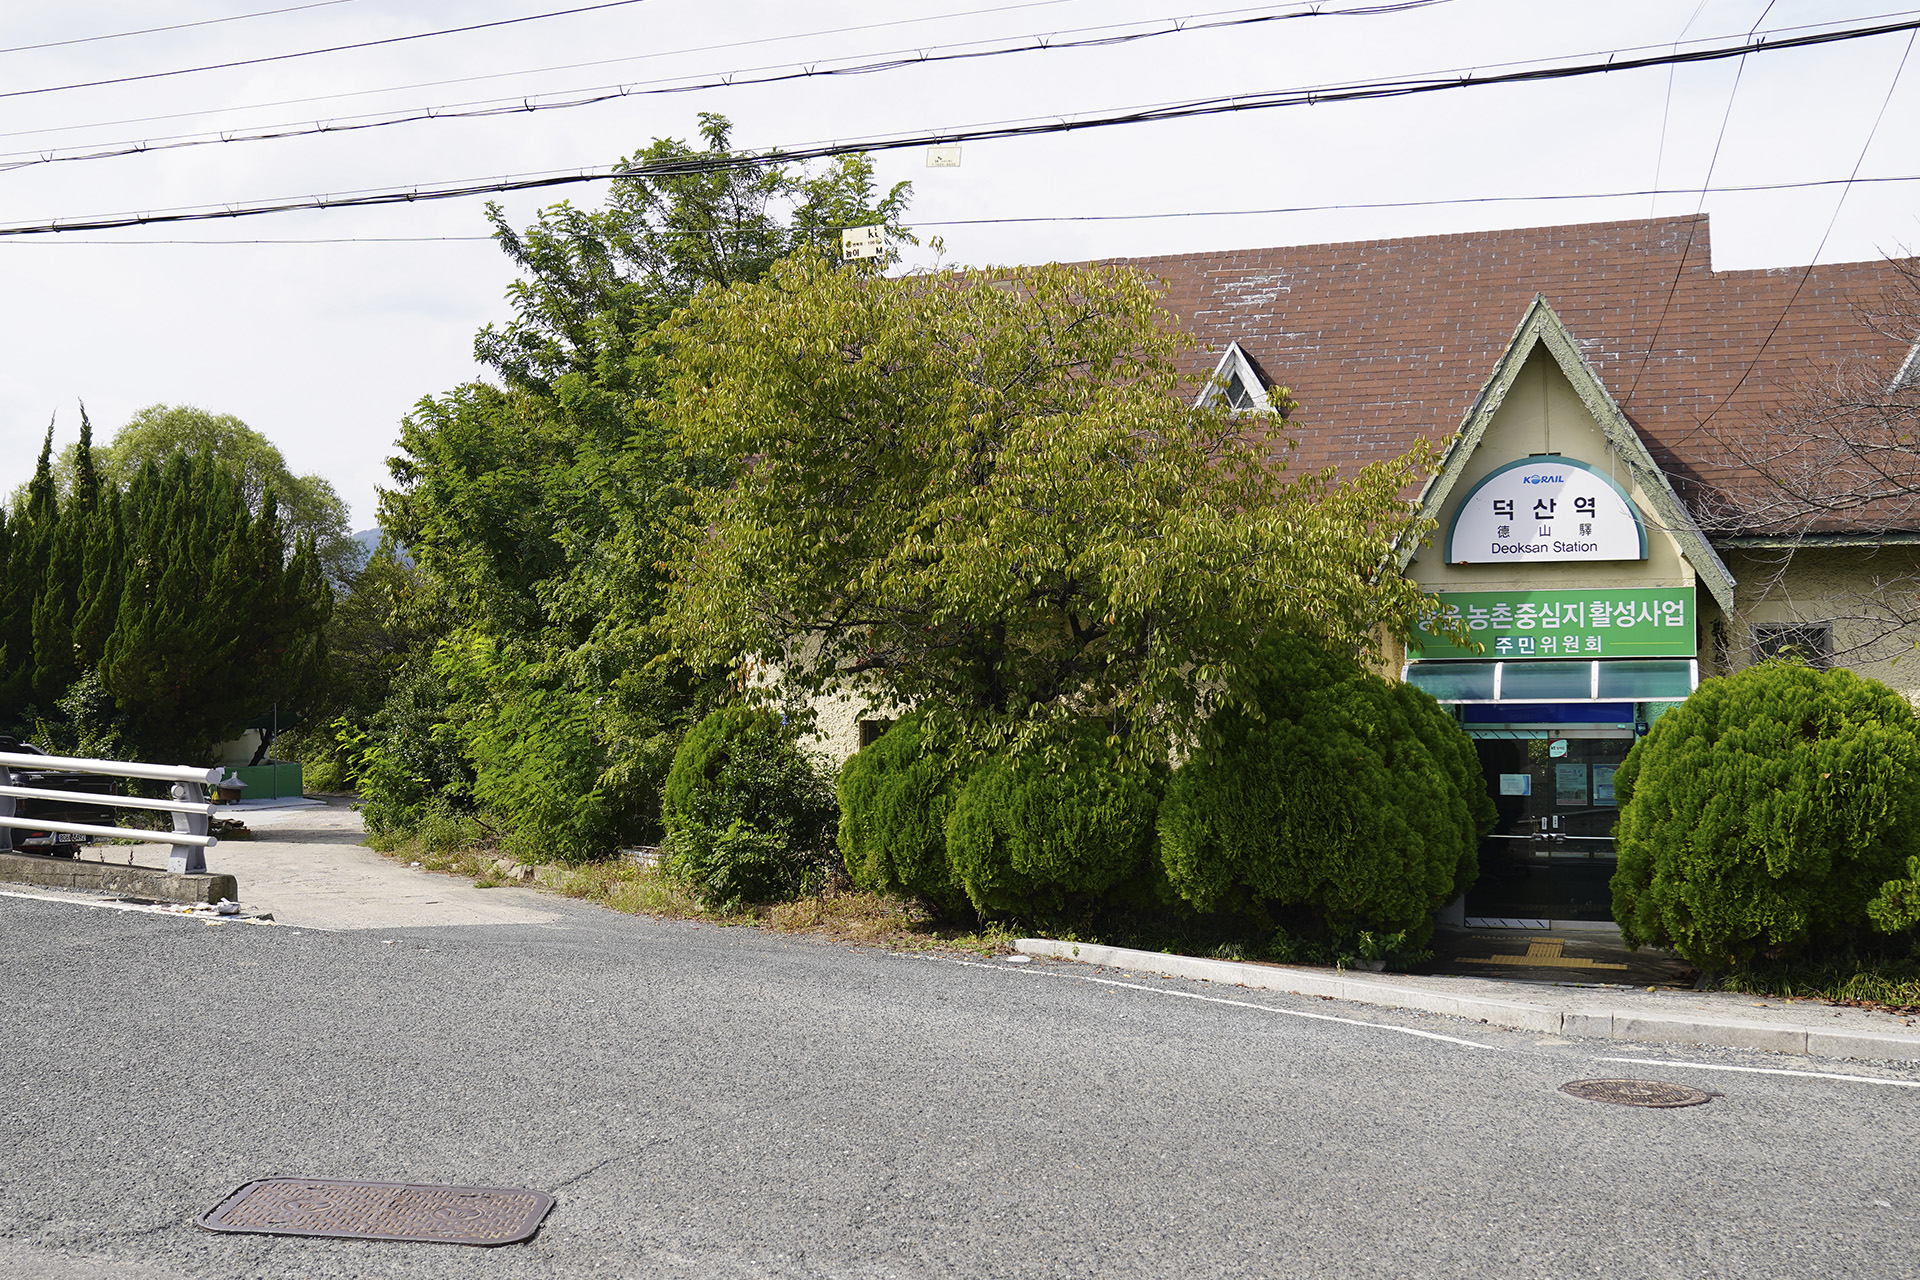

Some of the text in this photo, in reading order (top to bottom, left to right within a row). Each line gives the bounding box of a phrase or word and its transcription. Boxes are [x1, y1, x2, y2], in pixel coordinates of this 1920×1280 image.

[1523, 474, 1564, 485] KORAIL
[1491, 540, 1598, 554] Deoksan Station
